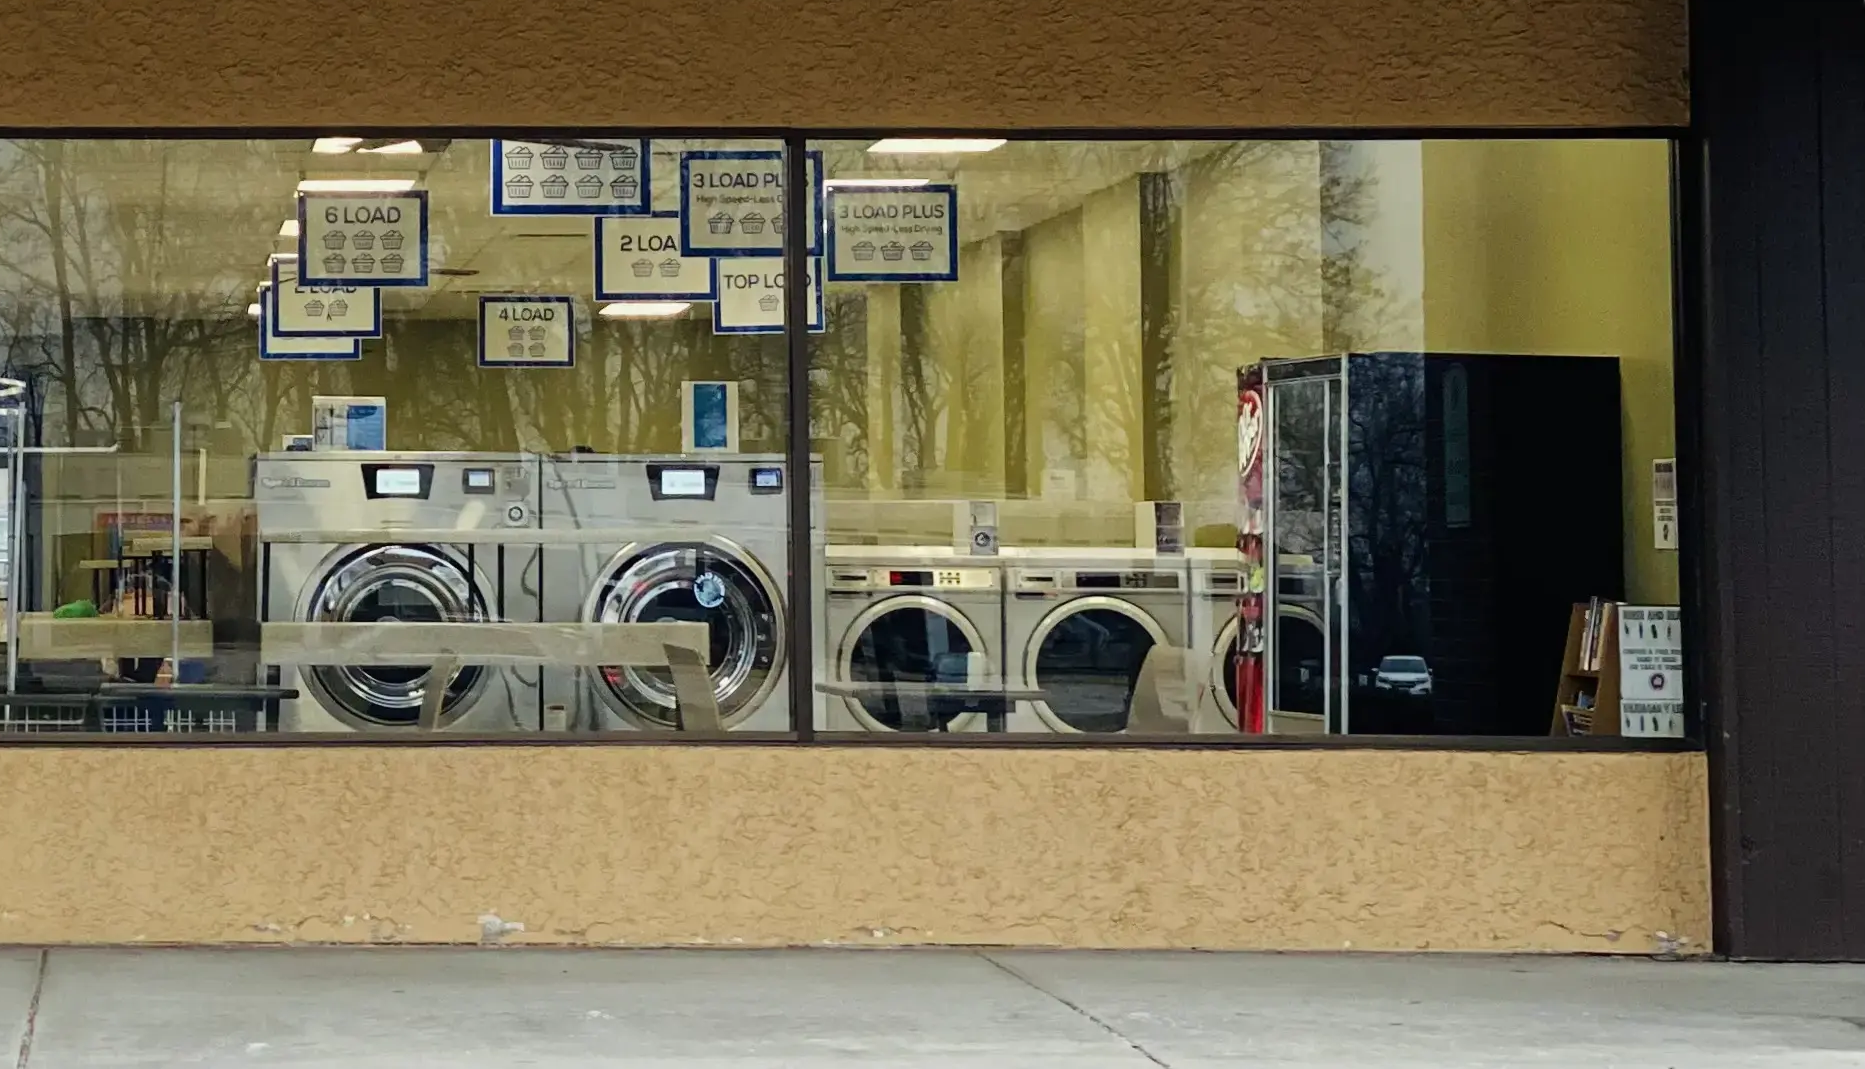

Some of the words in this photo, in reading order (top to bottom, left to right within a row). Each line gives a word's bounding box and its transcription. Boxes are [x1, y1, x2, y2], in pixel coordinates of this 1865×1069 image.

[693, 173, 705, 188] 3
[710, 173, 759, 188] LOAD
[696, 194, 717, 204] High
[325, 206, 338, 224] 6
[343, 206, 401, 224] LOAD
[839, 204, 849, 219] 3
[853, 204, 898, 219] LOAD
[902, 204, 944, 219] PLUS
[620, 235, 633, 252] 2
[638, 235, 679, 252] LOA
[723, 274, 760, 289] TOP
[499, 308, 509, 321] 4
[512, 308, 555, 322] LOAD
